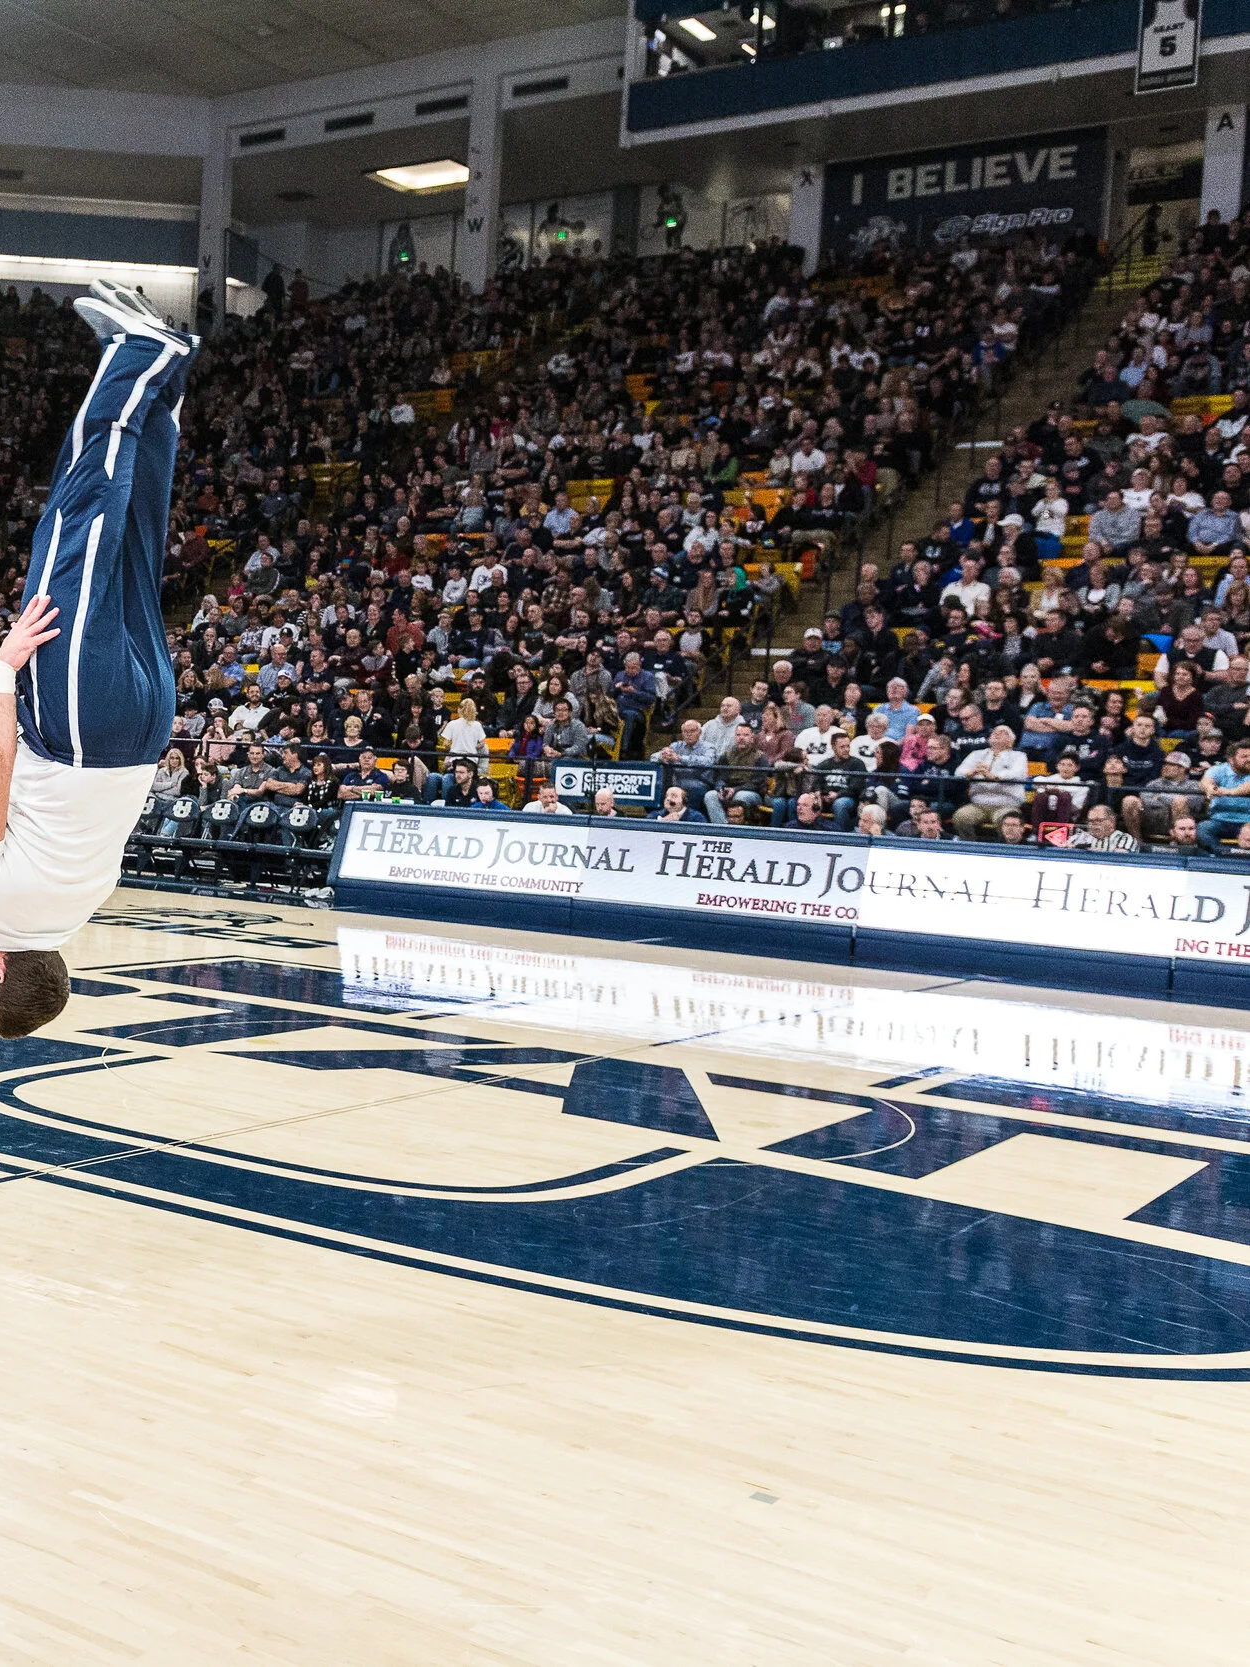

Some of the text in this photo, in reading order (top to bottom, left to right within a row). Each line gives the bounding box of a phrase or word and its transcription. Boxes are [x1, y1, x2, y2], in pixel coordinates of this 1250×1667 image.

[1159, 35, 1176, 57] 5
[1217, 113, 1233, 132] A
[851, 145, 1078, 205] I BELIEVE
[607, 774, 651, 786] SPORTS
[397, 819, 420, 831] THE
[356, 819, 635, 873] HERALD JOURNAL
[702, 840, 732, 854] THE
[388, 866, 584, 893] EMPOWERING THE COMMUNITY
[655, 840, 998, 904] HERALD JOURNAL
[696, 893, 797, 915] EMPOWERING
[800, 903, 831, 918] THE
[1031, 871, 1226, 923] HERALD
